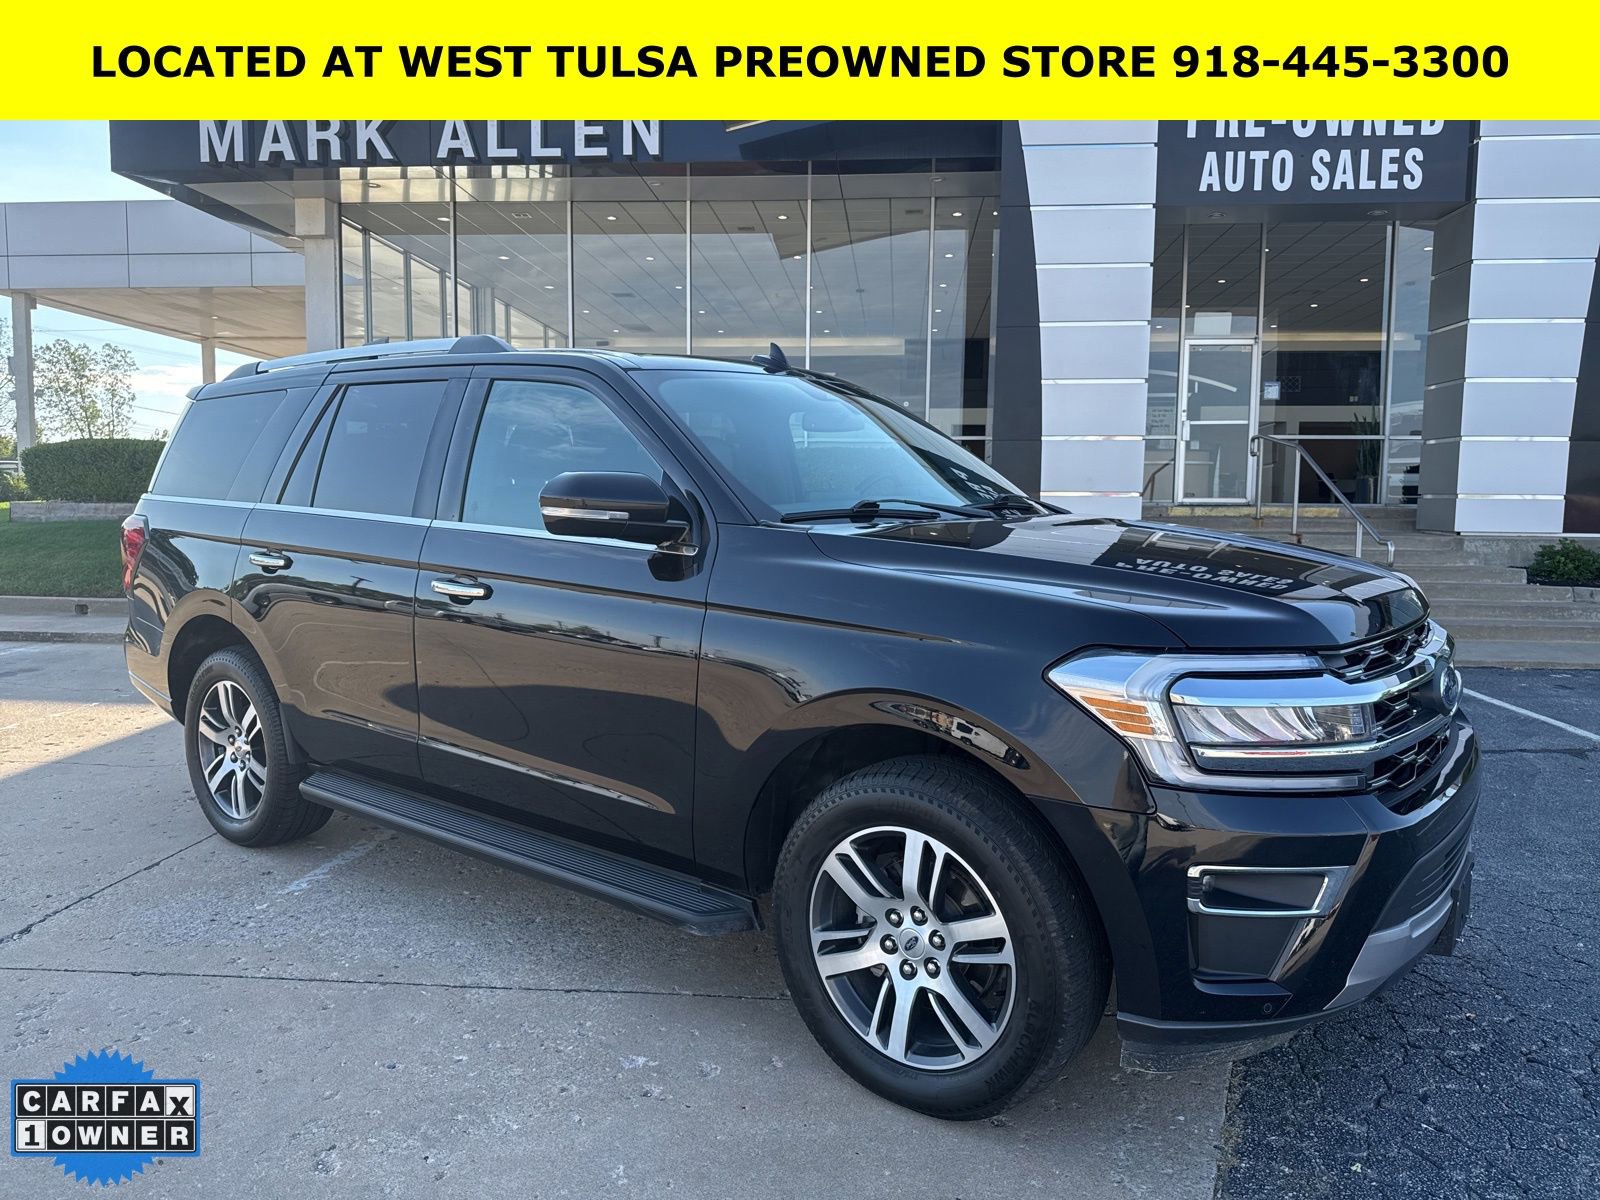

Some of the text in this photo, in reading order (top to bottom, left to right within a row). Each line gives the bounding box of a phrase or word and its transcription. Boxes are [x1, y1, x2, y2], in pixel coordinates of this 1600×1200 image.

[199, 120, 660, 162] MARK ALLEN
[1199, 147, 1424, 192] AUTO SALES
